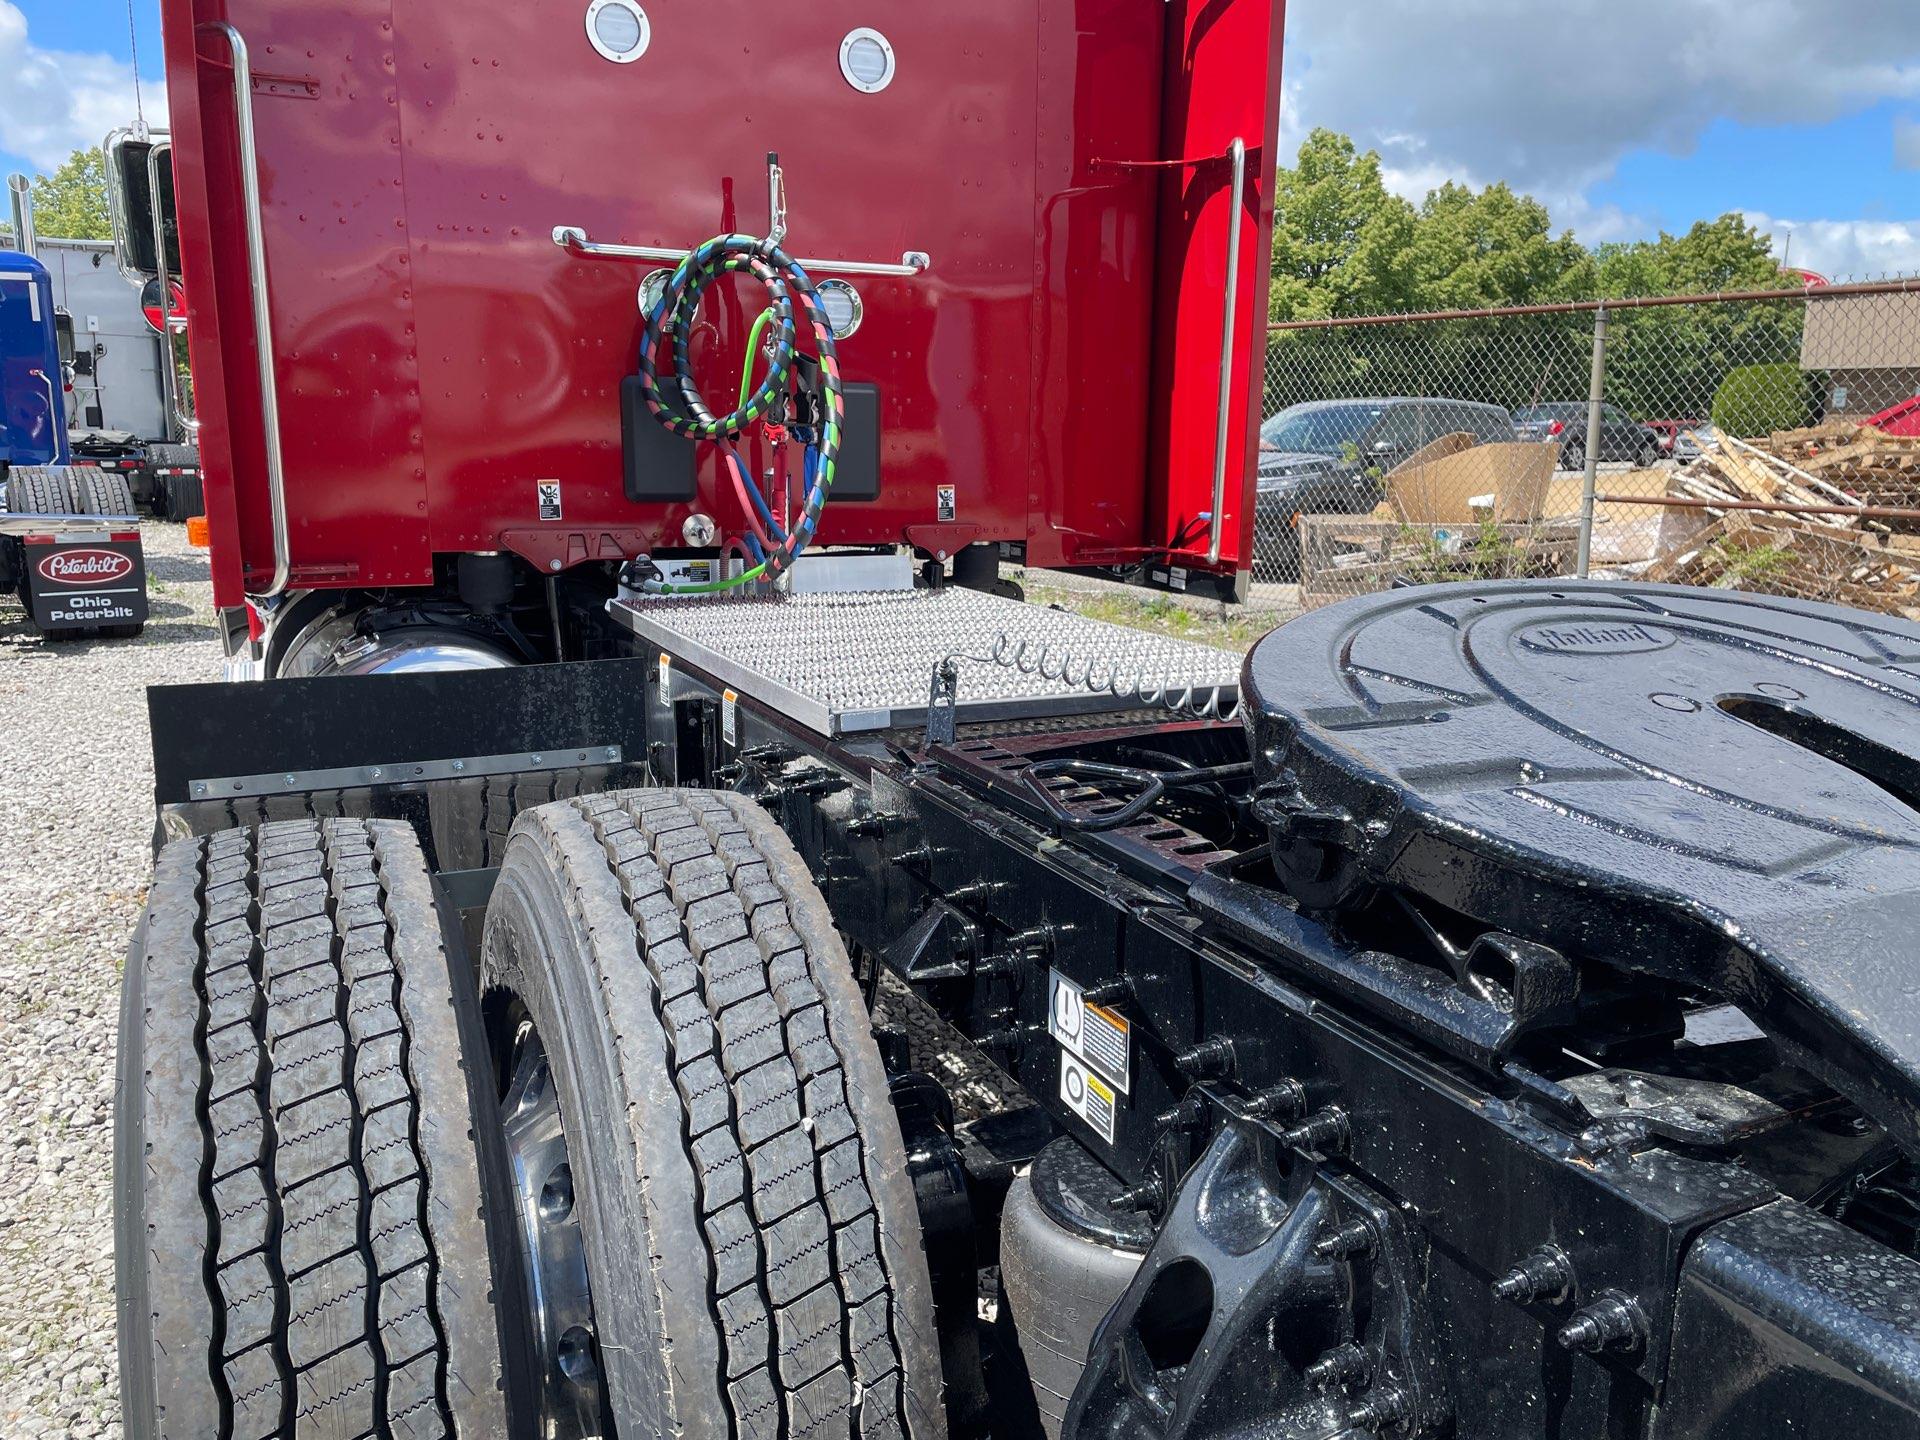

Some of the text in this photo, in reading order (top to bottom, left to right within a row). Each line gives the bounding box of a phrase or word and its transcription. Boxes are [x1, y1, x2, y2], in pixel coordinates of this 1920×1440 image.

[50, 556, 125, 577] Peterbilt
[69, 596, 112, 608] Ohio
[50, 607, 134, 621] Peterbilt
